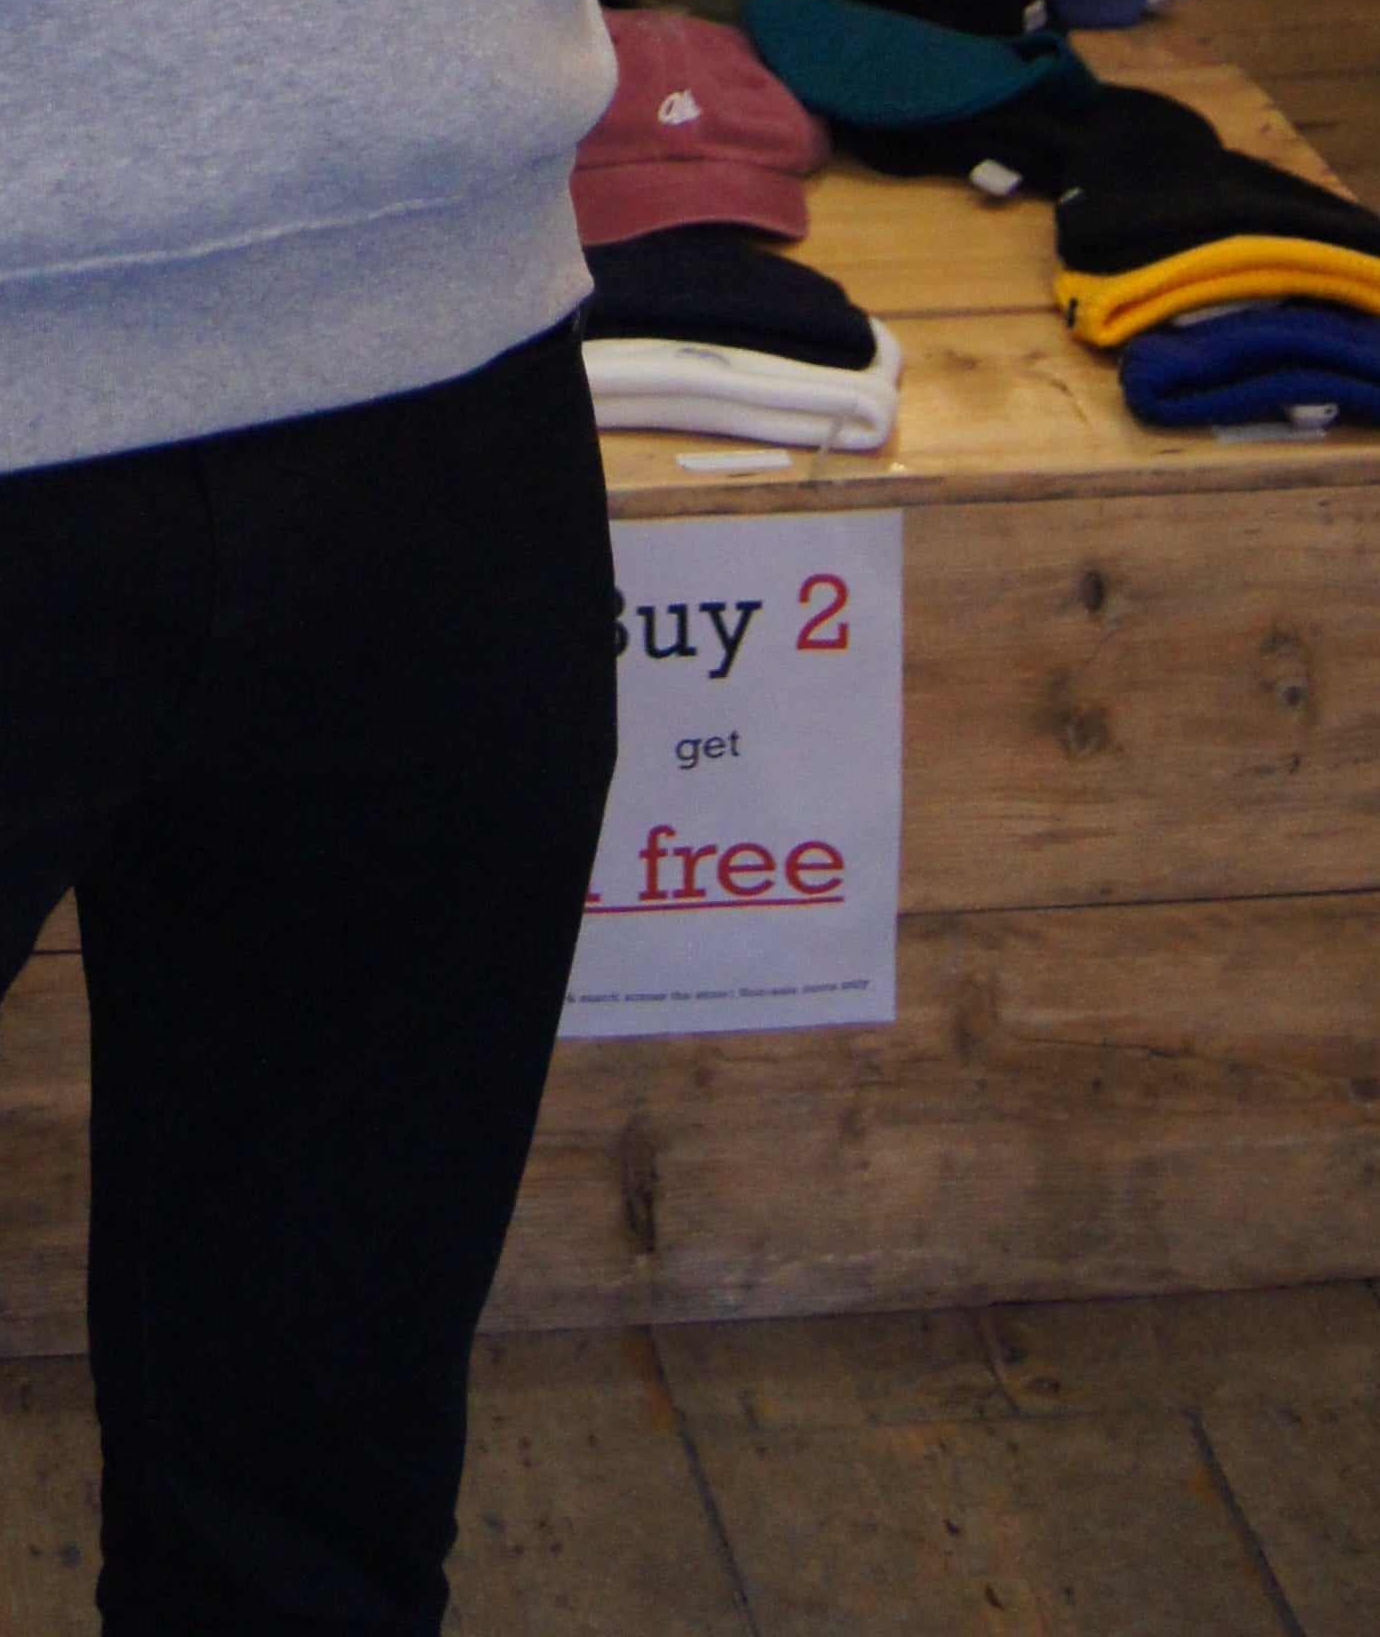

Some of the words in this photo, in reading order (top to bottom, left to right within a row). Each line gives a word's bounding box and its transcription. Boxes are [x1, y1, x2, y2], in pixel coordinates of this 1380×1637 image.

[617, 586, 763, 679] uy
[795, 573, 849, 651] 2
[675, 730, 741, 770] get
[638, 824, 846, 901] free
